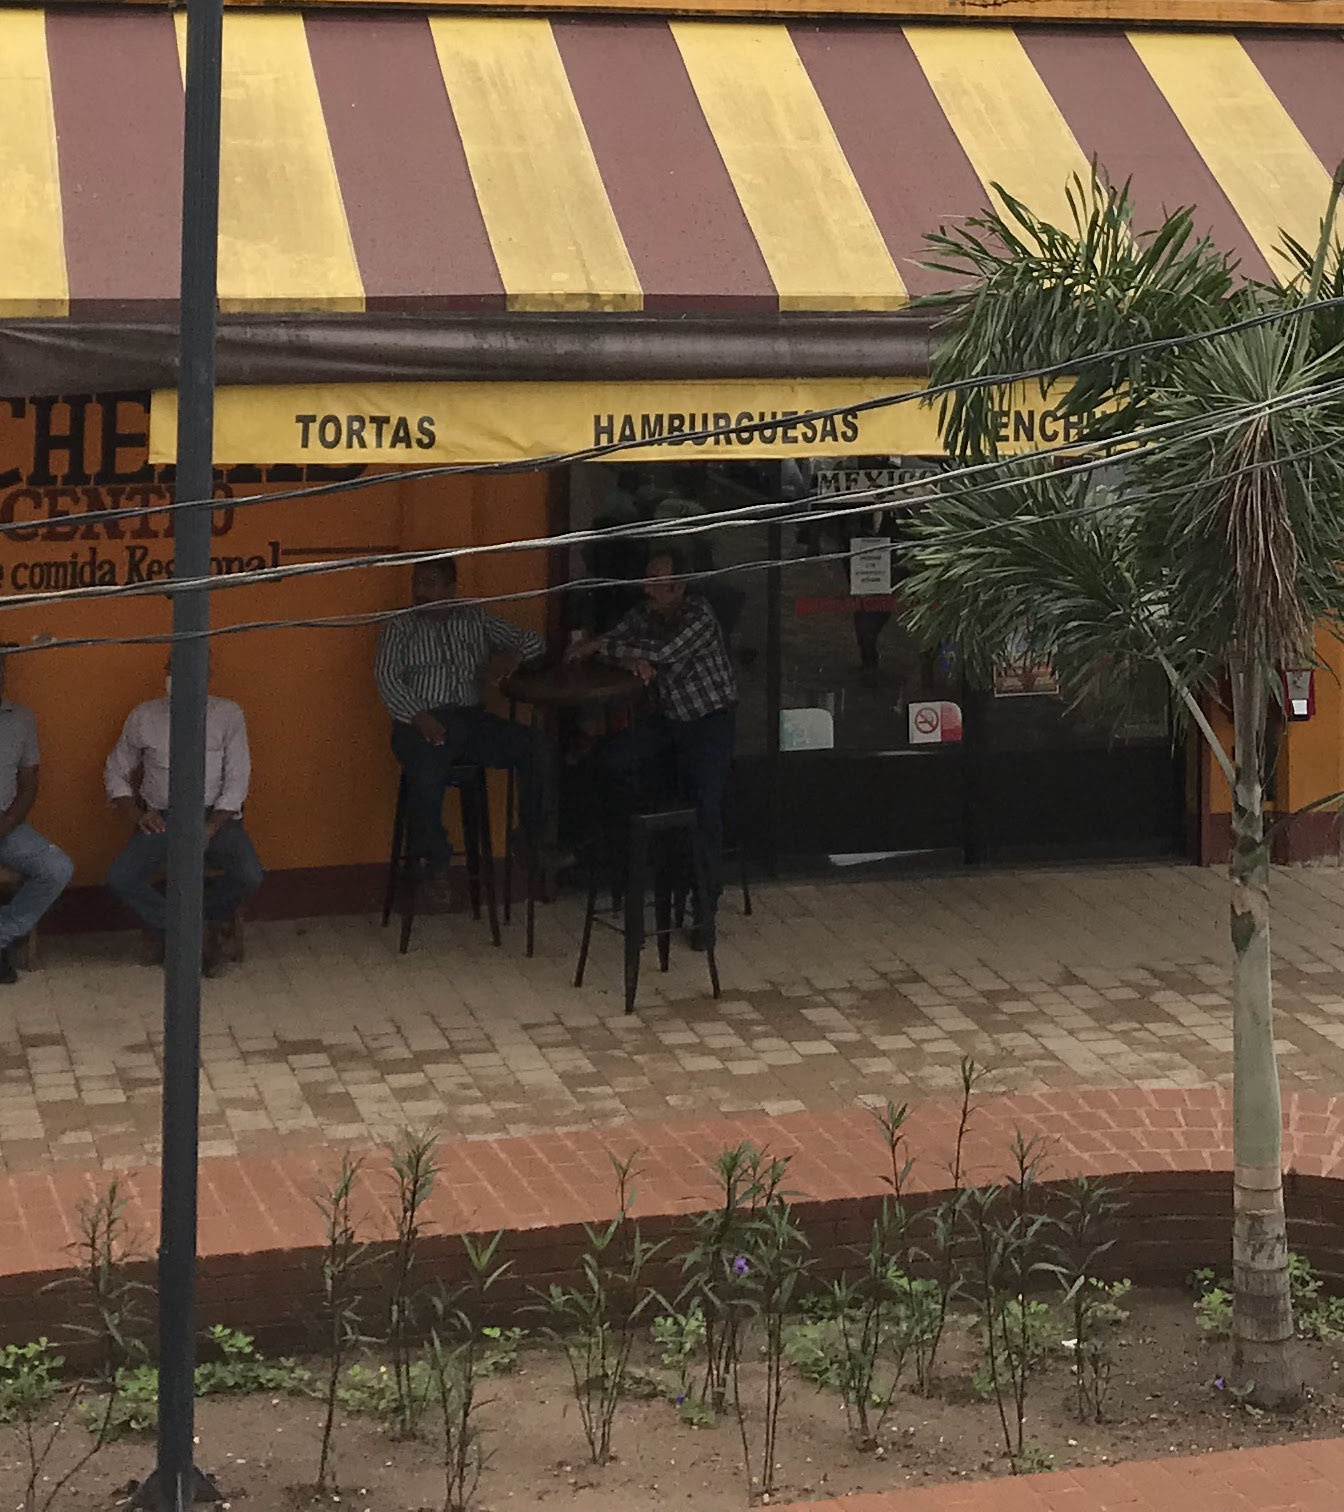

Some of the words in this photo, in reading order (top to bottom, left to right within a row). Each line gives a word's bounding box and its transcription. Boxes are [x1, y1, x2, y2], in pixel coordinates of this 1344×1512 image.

[296, 414, 436, 450] TORTAS
[593, 409, 859, 446] HAMBURGUESAS
[818, 468, 942, 498] MEXICO
[11, 548, 117, 590] comida
